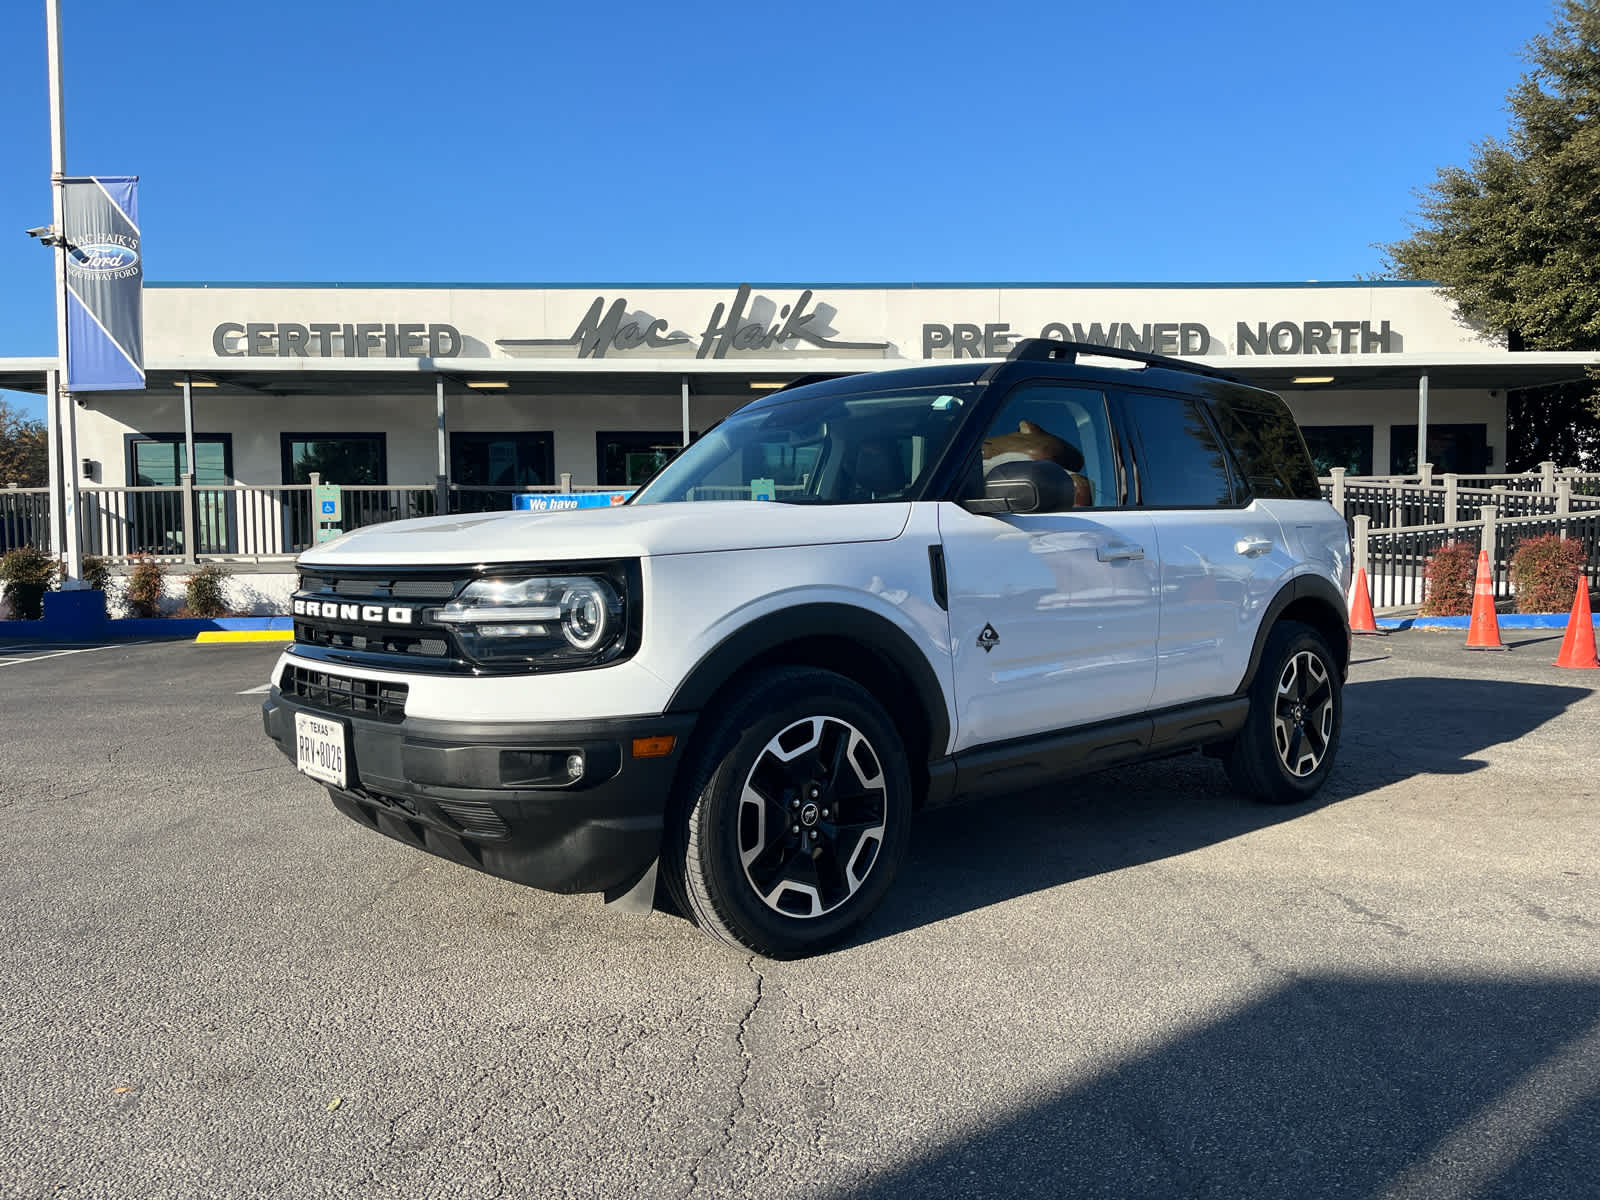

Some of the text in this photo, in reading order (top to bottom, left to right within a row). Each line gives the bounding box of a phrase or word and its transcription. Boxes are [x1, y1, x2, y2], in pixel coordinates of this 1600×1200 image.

[97, 232, 138, 250] HAIK'S
[79, 248, 125, 267] Ford
[114, 266, 139, 280] FORD
[495, 283, 890, 359] Mac Haik
[213, 322, 462, 358] CERTIFIED
[922, 323, 1011, 359] PRE
[1236, 320, 1391, 356] NORTH
[529, 498, 579, 511] We have
[294, 600, 413, 624] BRONCO
[310, 721, 329, 737] TEXAS
